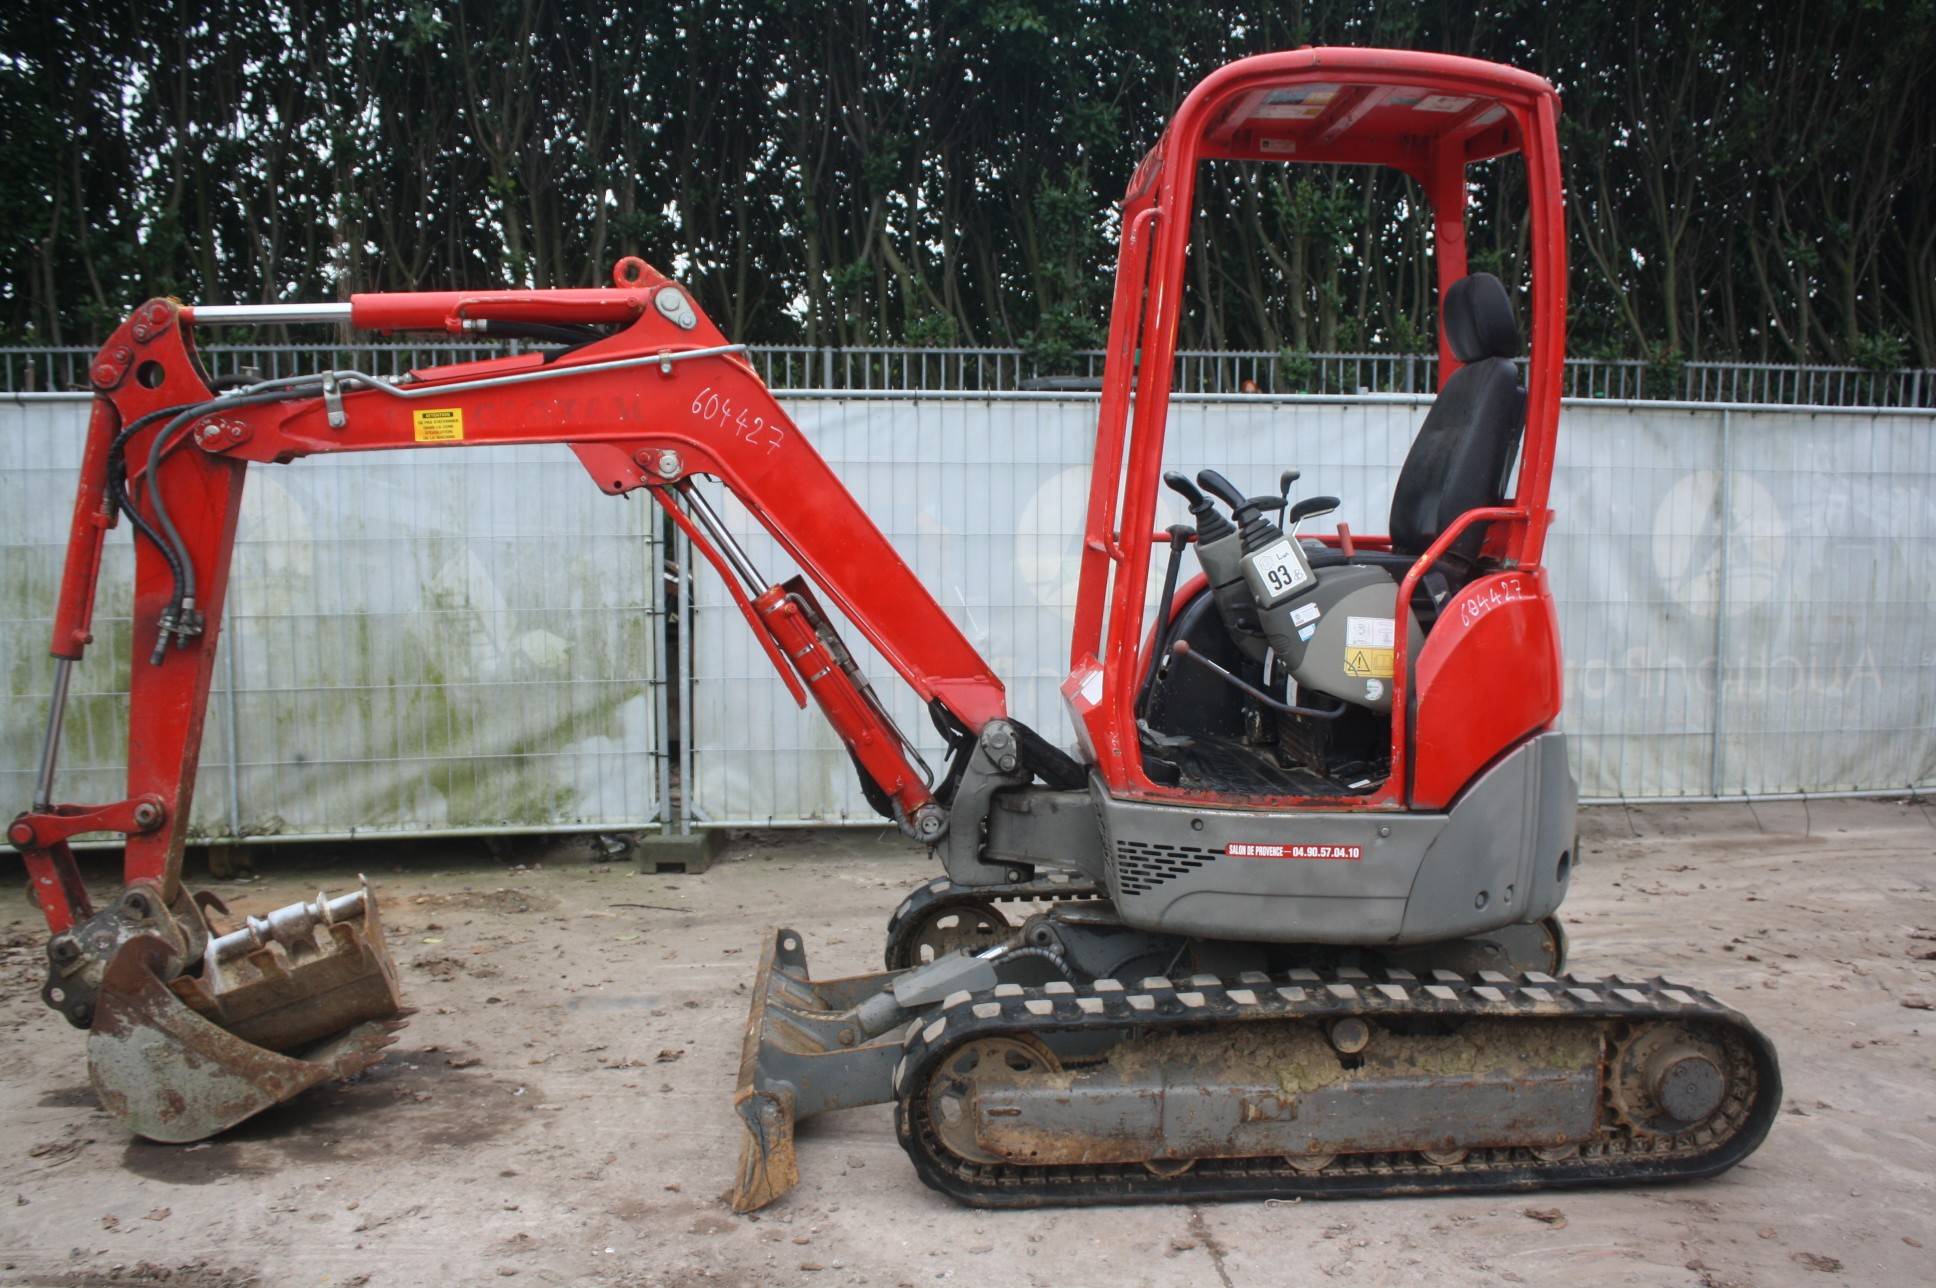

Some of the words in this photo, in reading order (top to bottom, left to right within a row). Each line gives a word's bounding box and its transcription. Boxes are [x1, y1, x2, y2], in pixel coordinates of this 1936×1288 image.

[692, 387, 784, 455] 604427
[1268, 565, 1292, 590] 93
[1229, 844, 1246, 855] SALON
[1247, 845, 1255, 855] DE
[1255, 846, 1283, 857] PROVENCE
[1292, 846, 1360, 858] 04.90.57.04.10
